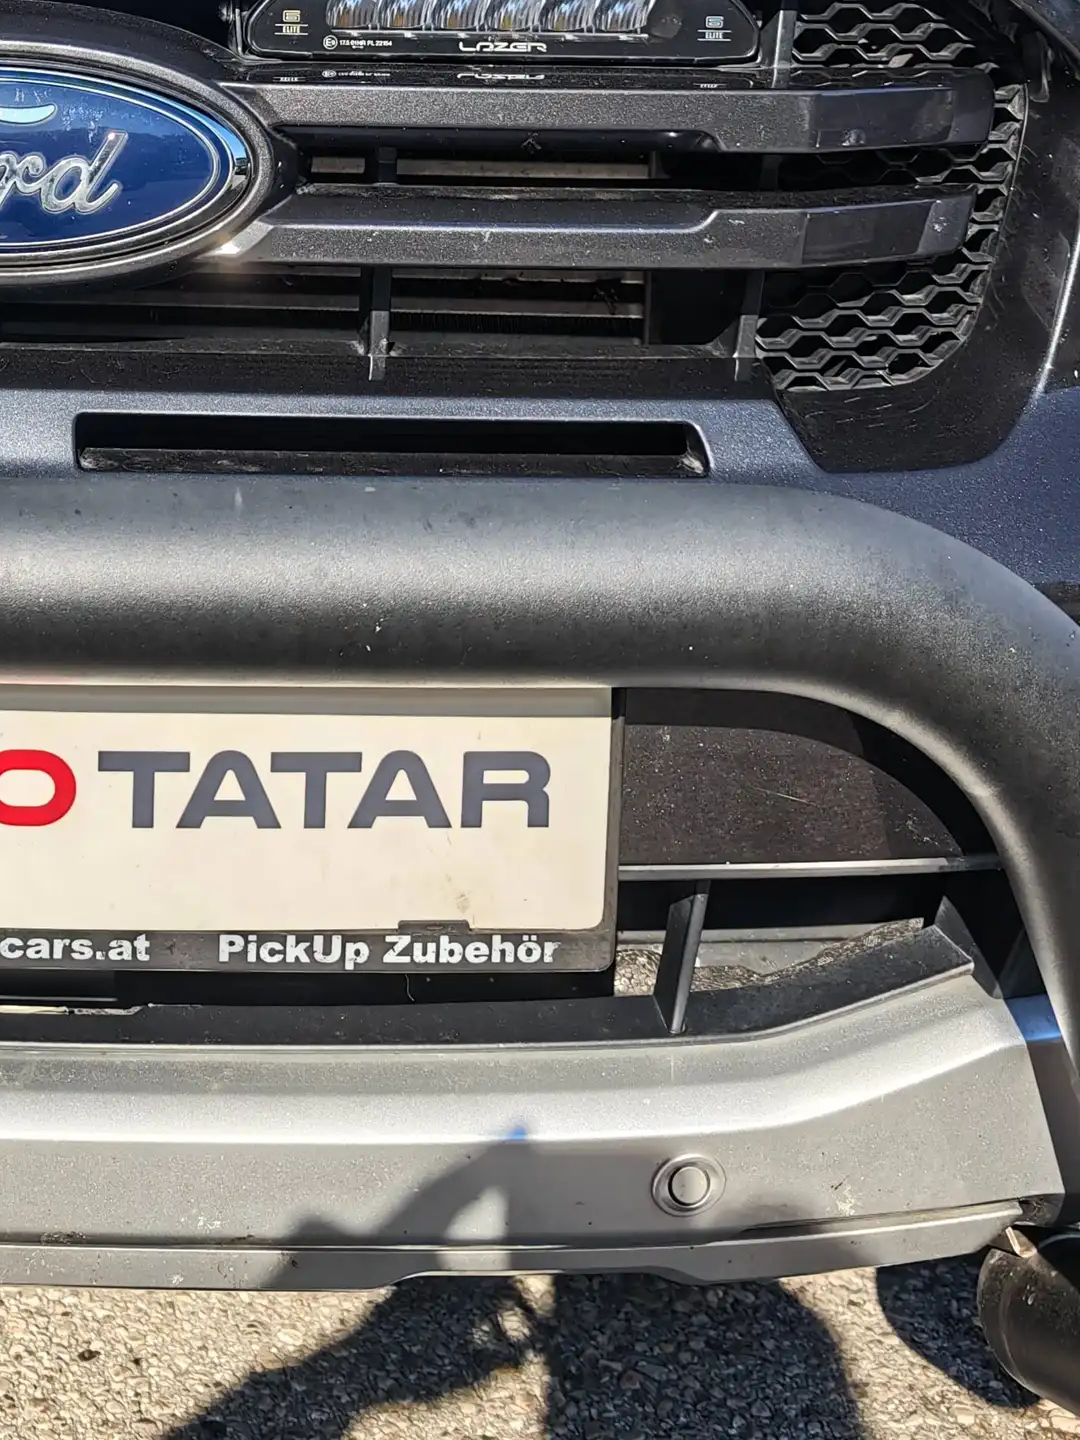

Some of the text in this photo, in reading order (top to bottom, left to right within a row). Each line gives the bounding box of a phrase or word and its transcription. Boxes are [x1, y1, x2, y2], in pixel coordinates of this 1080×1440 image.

[459, 41, 547, 53] LAZER
[97, 749, 552, 829] TATAR
[218, 933, 562, 971] PickUp Zubehör
